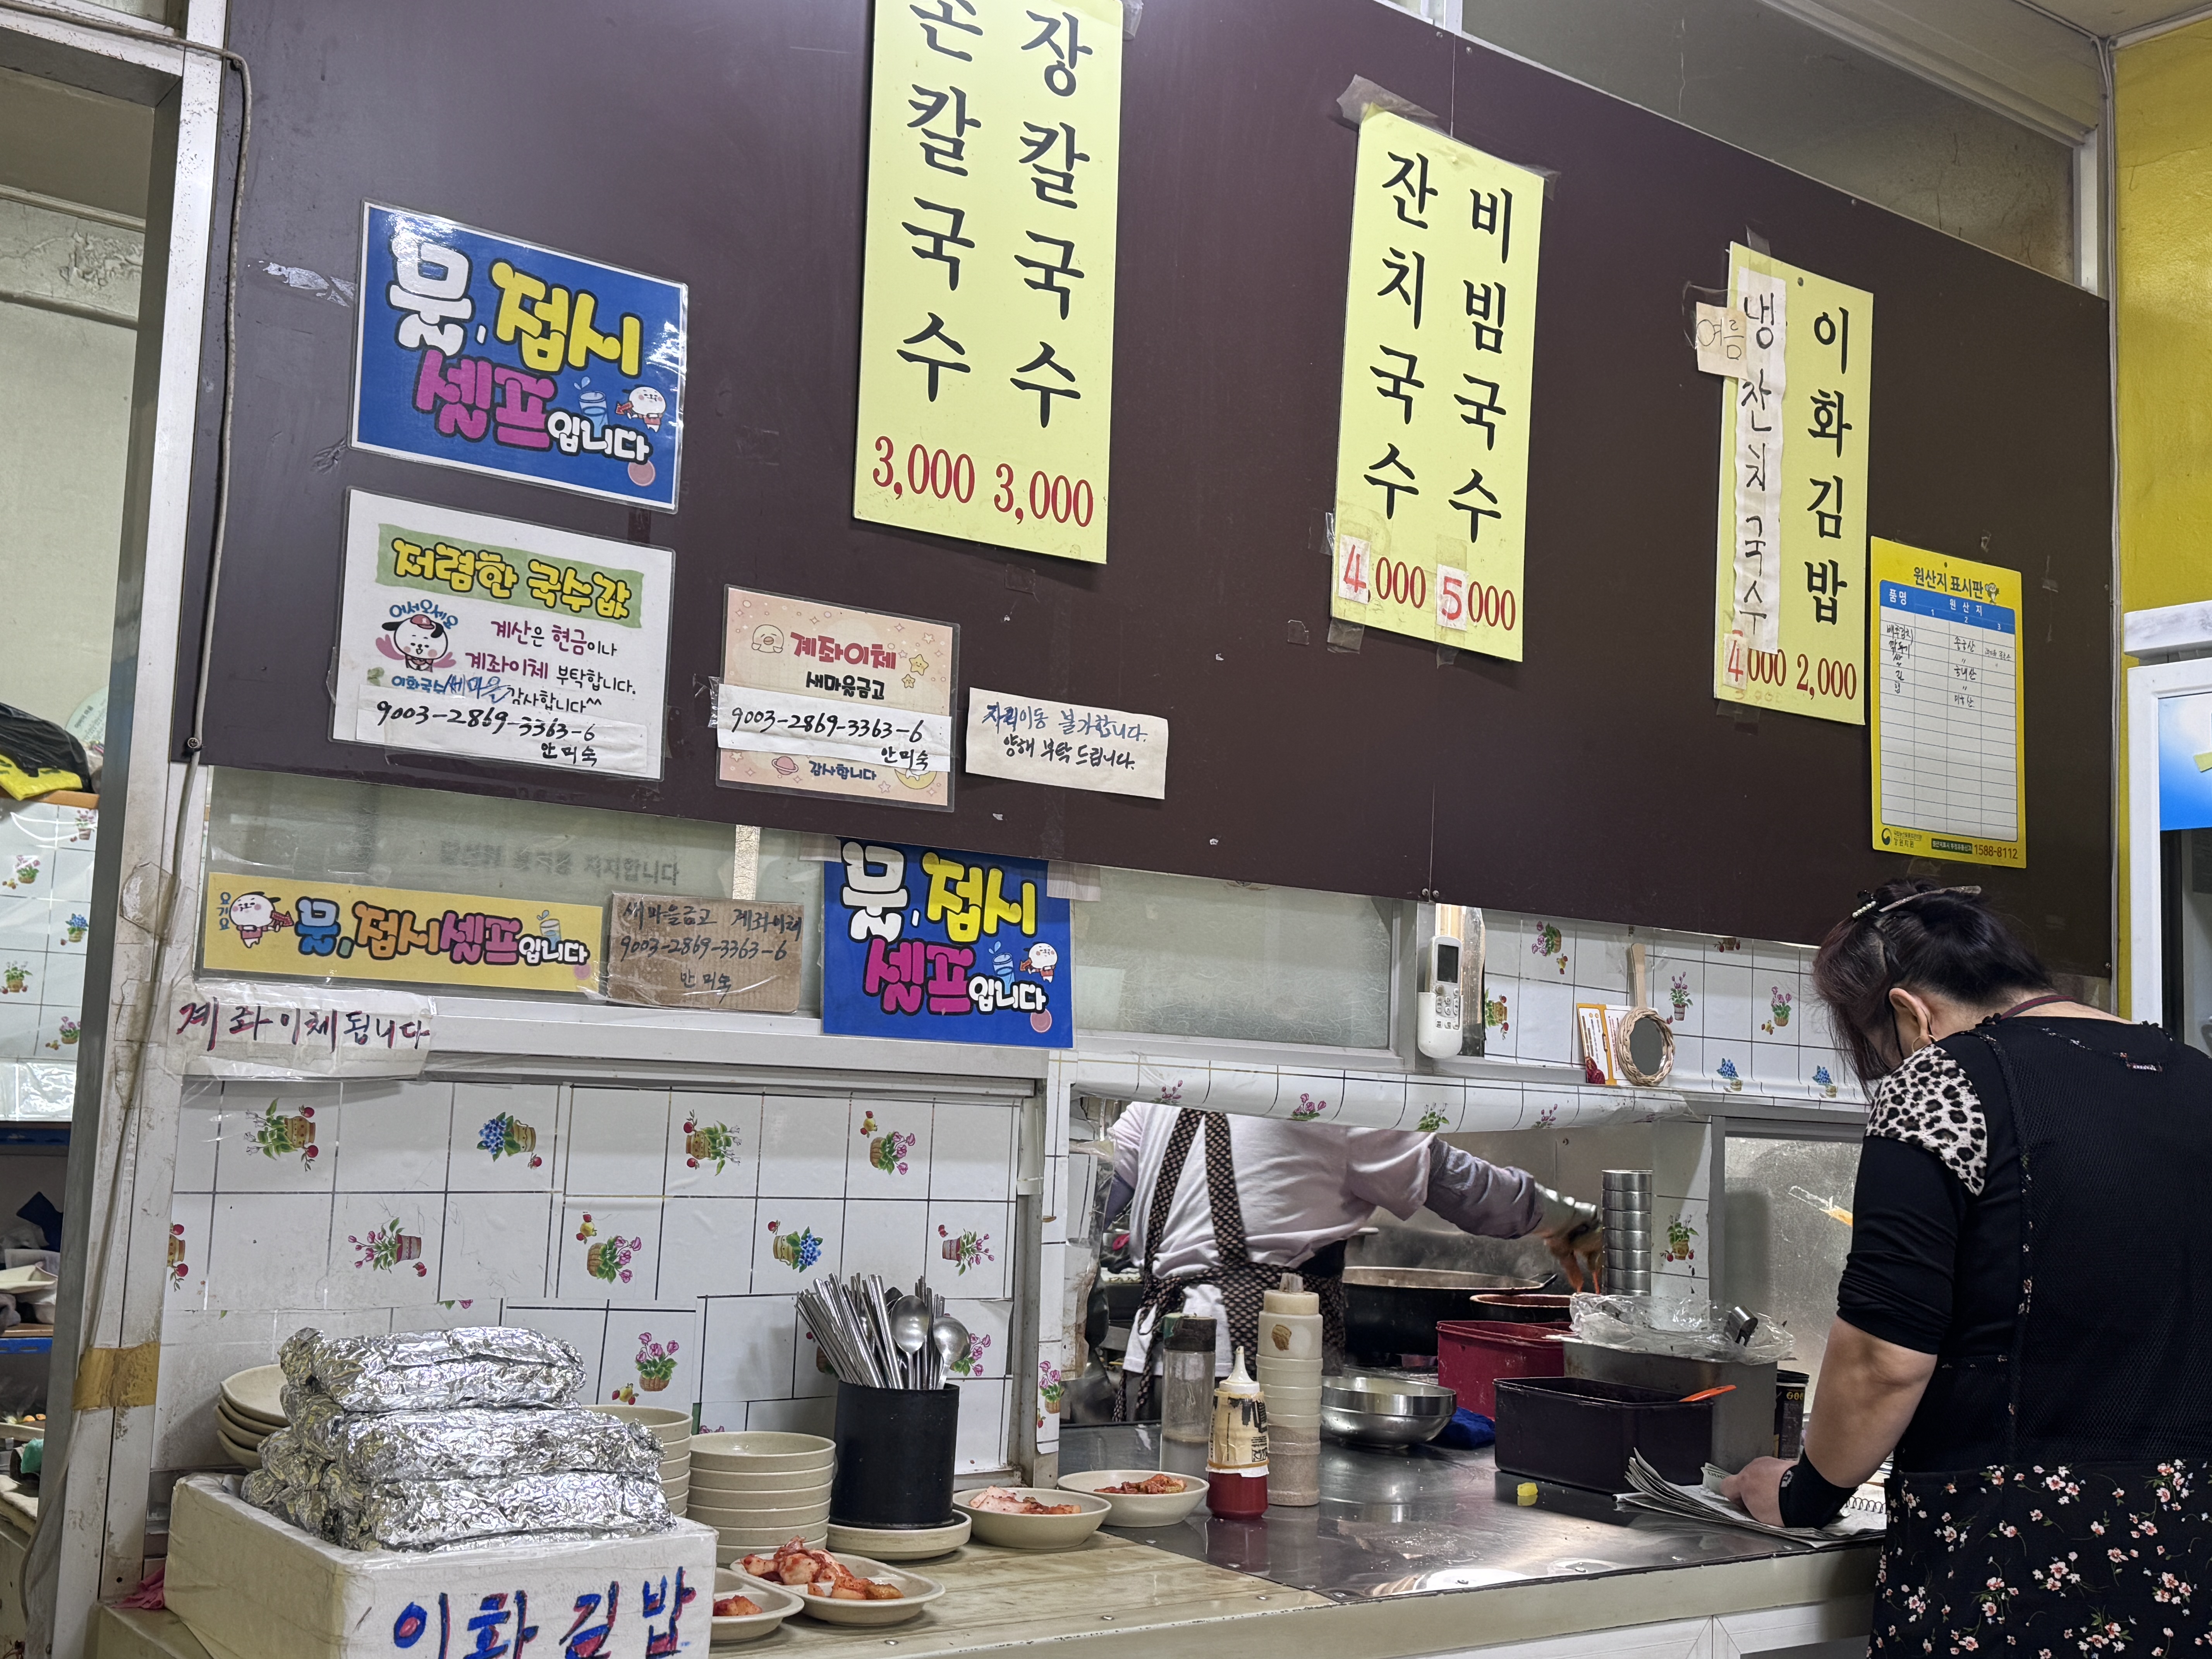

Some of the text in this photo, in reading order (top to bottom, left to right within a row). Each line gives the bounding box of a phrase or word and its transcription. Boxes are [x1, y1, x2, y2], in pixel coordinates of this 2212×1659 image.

[1010, 10, 1093, 429] 장칼국수
[489, 259, 643, 378] 접시
[1364, 151, 1438, 520] 잔치국수
[1698, 317, 1745, 361] 여름
[1448, 187, 1514, 543] 비빔국수
[872, 435, 975, 505] 3,000
[1804, 306, 1853, 625] 이화김밥
[994, 462, 1094, 528] 3,000
[392, 538, 519, 600] 저렴한
[1913, 567, 1983, 600] 원산지 표시판
[1889, 589, 1906, 605] 품명
[491, 620, 617, 657] 계산은 현금이나
[790, 632, 896, 670] 계좌이체
[465, 652, 636, 694] 계좌이체 부탁합니다.
[806, 672, 885, 700] 새마을금고
[1796, 653, 1857, 700] 2,000
[732, 707, 924, 743] 9003-2869-3363-6
[1003, 733, 1034, 757] 양해
[809, 760, 877, 781] 감사합니다
[1975, 845, 2018, 859] 1588-8112
[921, 850, 1037, 943] 접시
[620, 935, 787, 962] 9003-2869-3363-6
